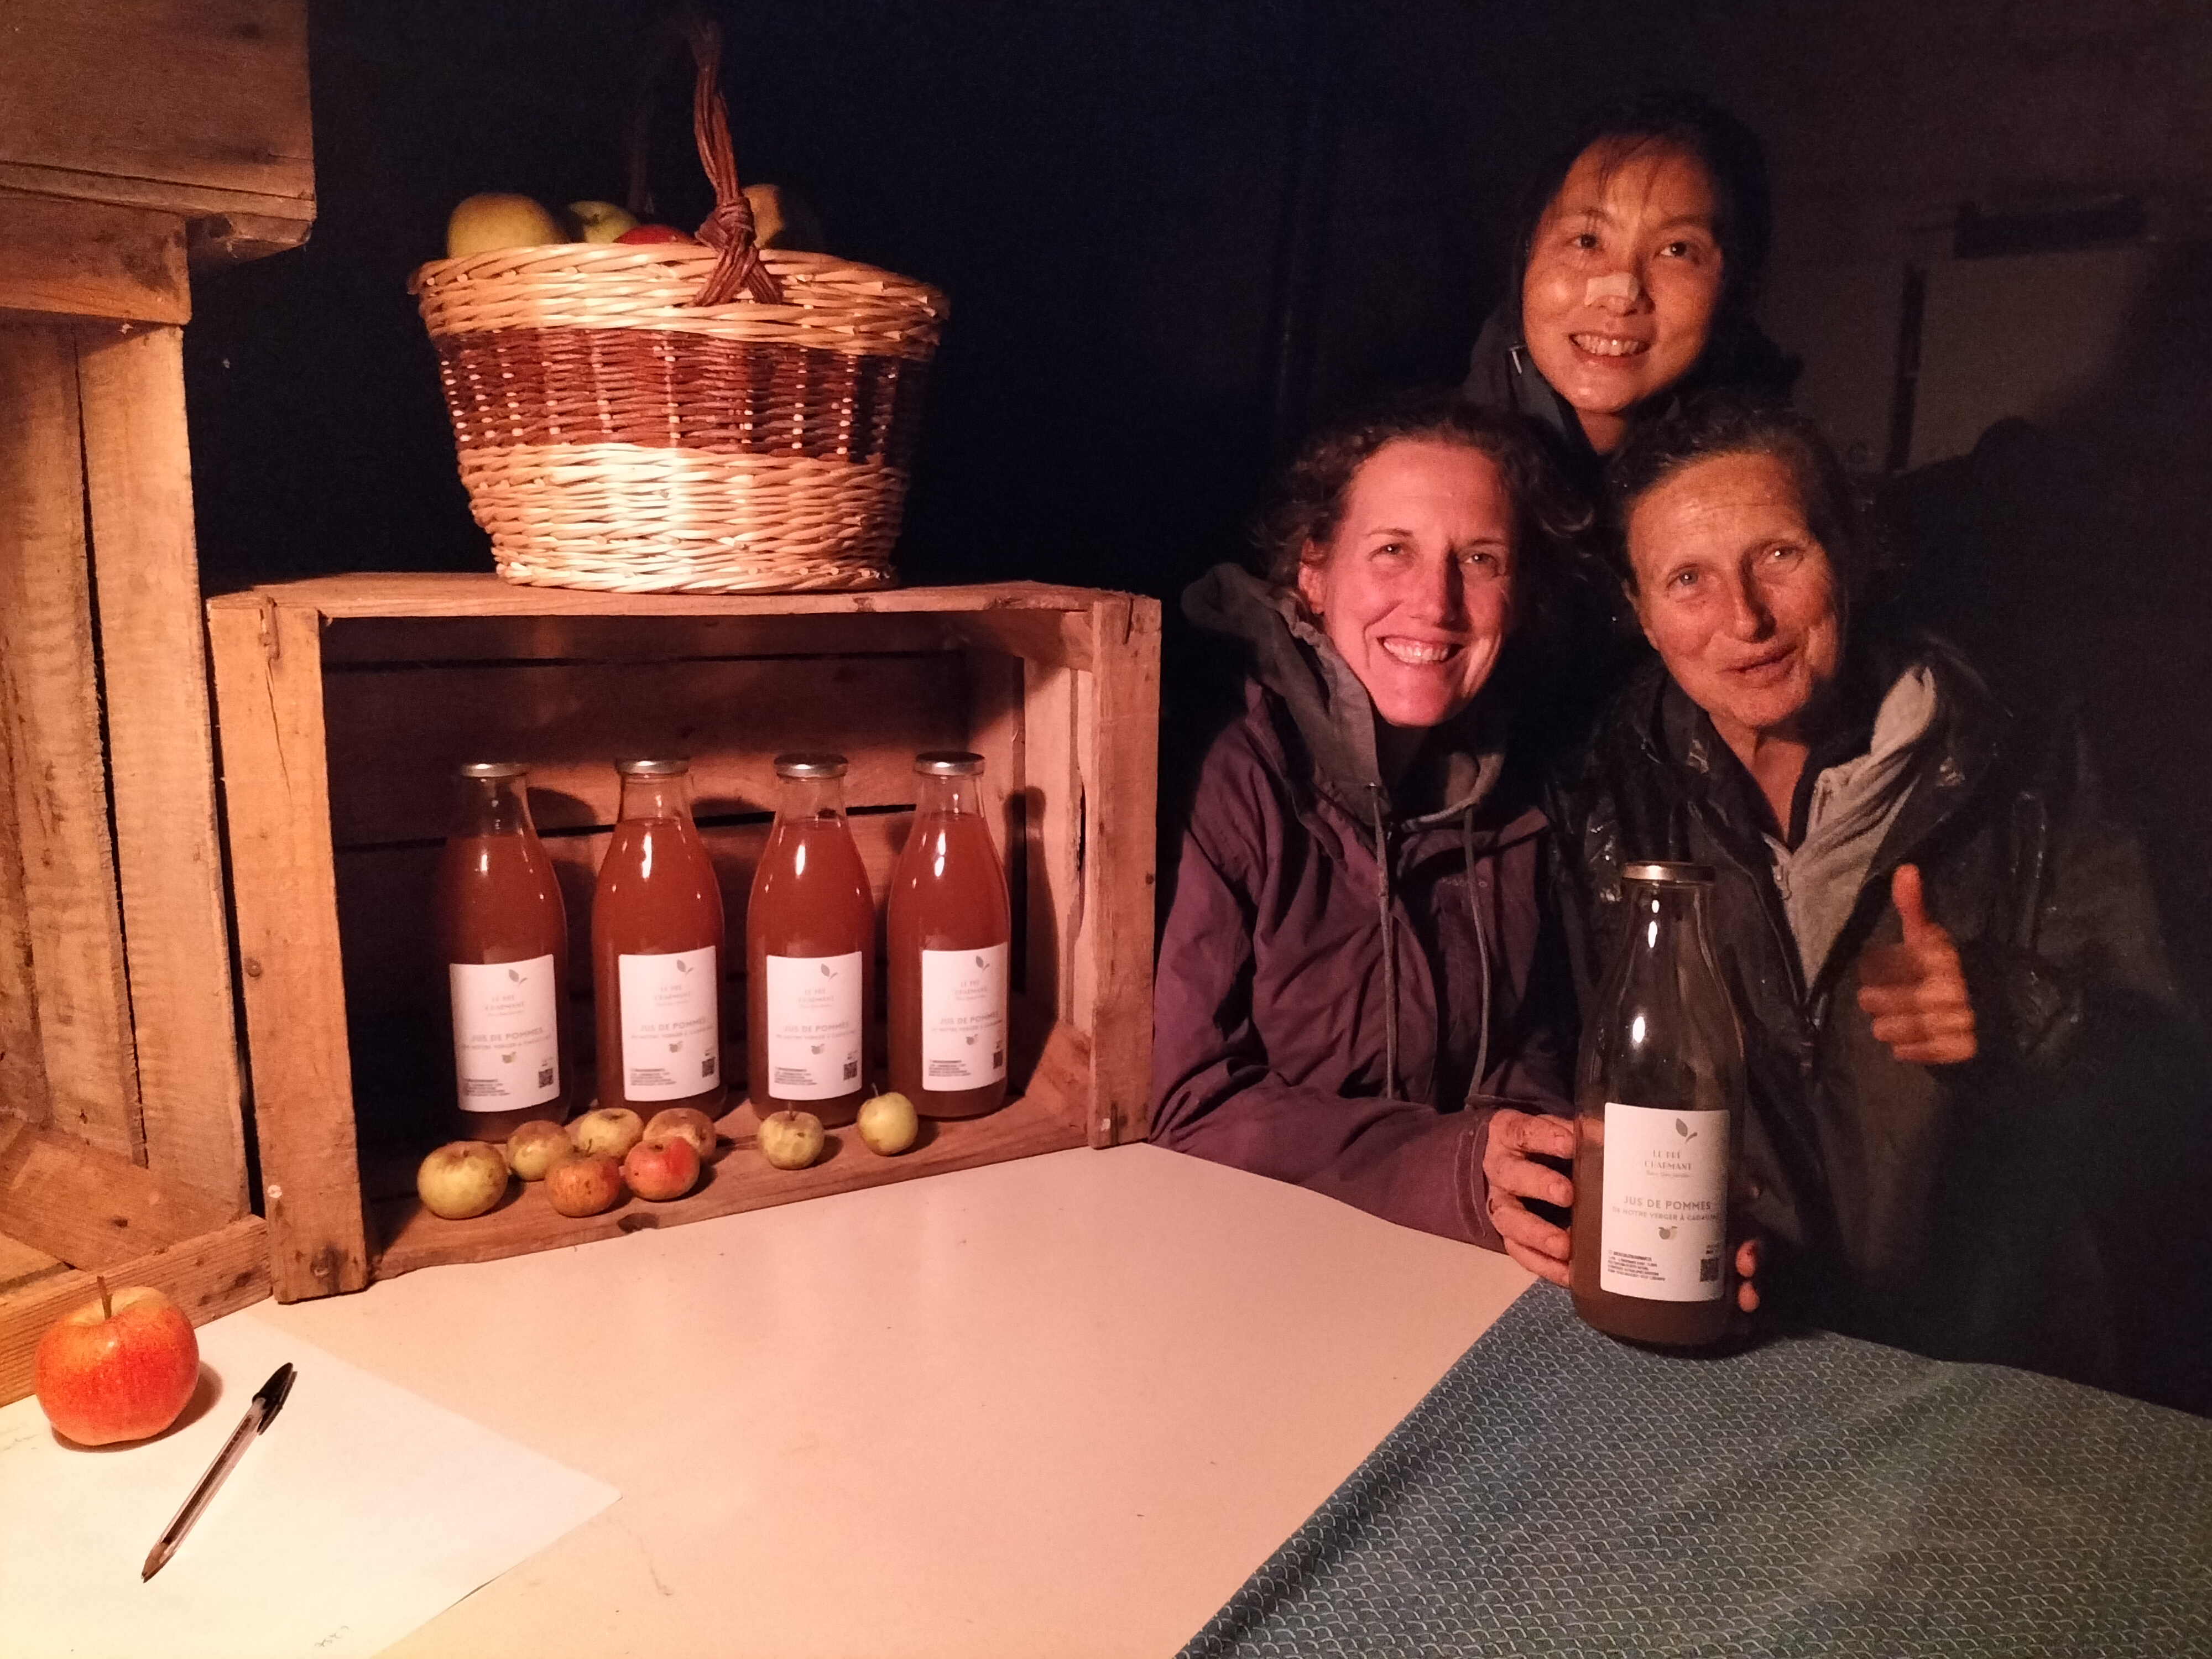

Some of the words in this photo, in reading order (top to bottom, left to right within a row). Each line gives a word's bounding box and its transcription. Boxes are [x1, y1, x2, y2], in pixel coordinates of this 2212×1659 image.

[505, 1026, 544, 1040] POMMES
[816, 1021, 849, 1032] POMMES
[1623, 1195, 1642, 1206] JUS
[1647, 1199, 1661, 1209] DE
[1666, 1201, 1711, 1211] POMMES
[1623, 1208, 1647, 1218] NOTRE
[1649, 1212, 1677, 1221] VERGER
